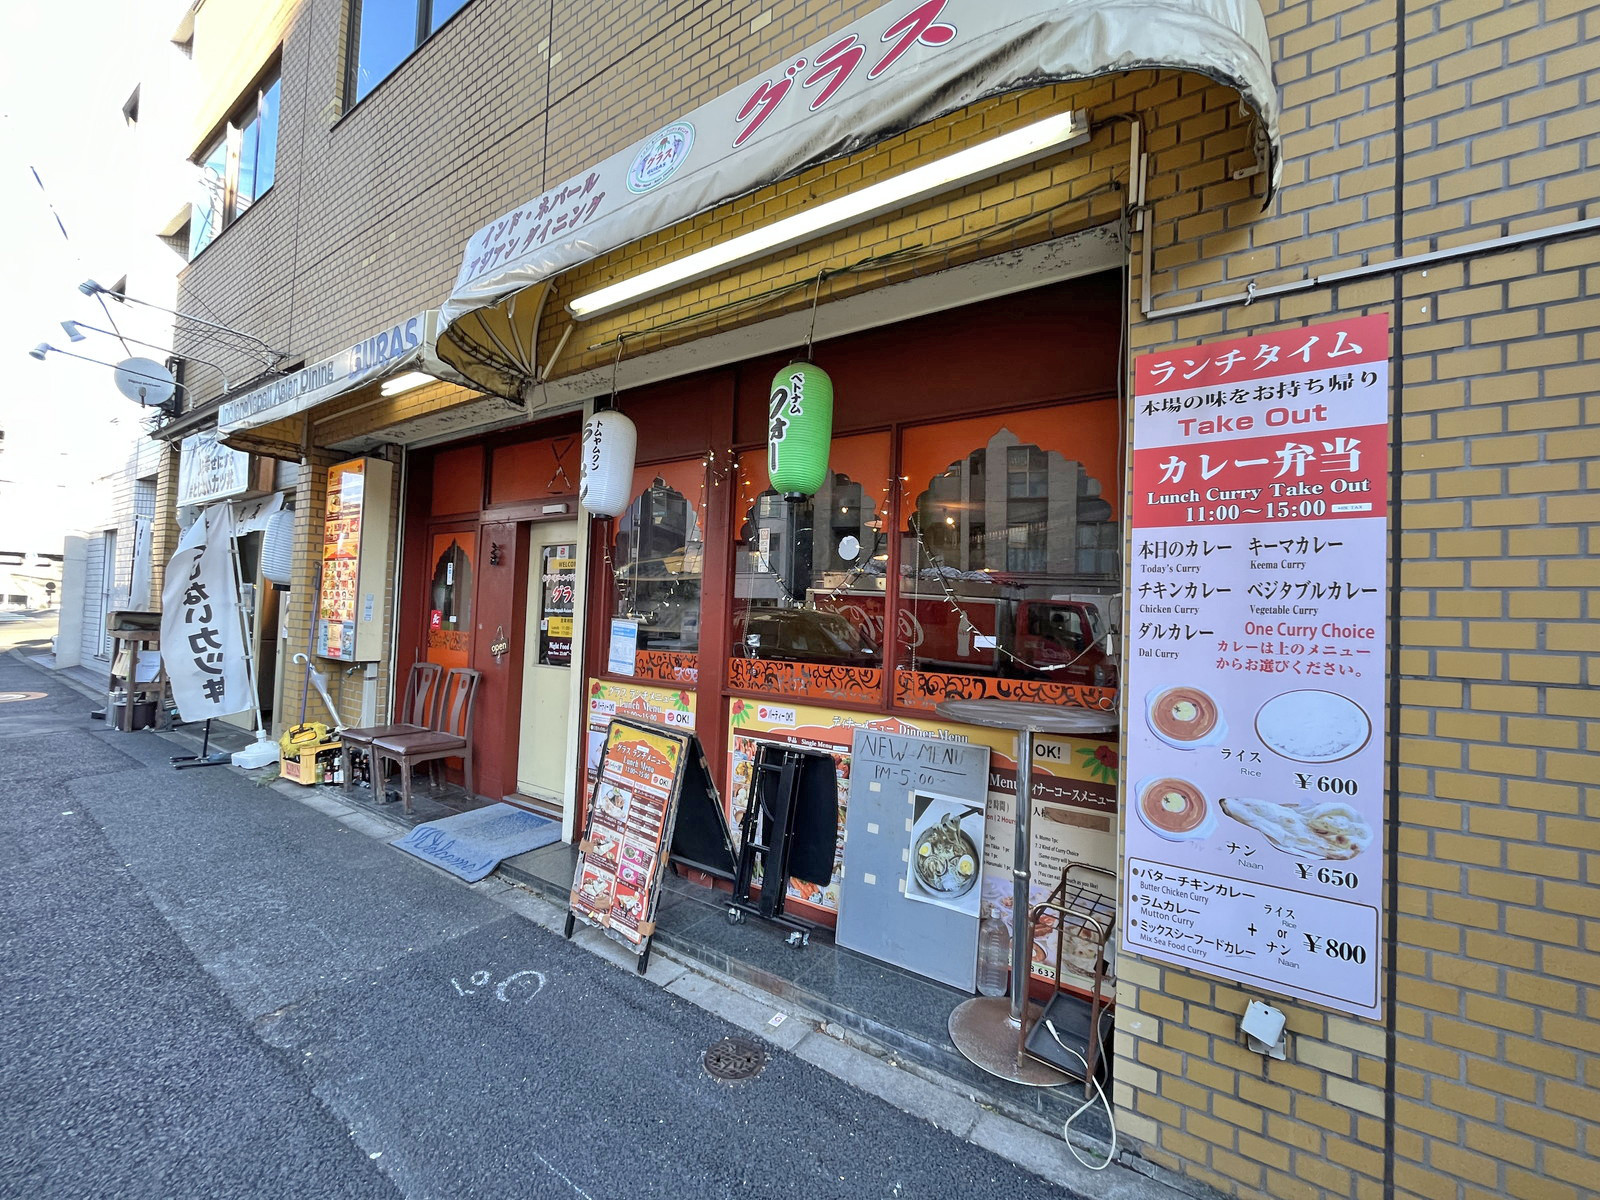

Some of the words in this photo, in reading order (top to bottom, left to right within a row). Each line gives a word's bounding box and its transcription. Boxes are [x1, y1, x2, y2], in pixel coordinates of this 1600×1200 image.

[732, 0, 958, 148] グラス
[646, 148, 673, 170] グラス
[482, 172, 601, 249] インド・ネパール
[349, 317, 419, 379] GURAS
[1150, 331, 1364, 387] ランチタイム
[274, 378, 298, 404] Asian
[301, 361, 334, 392] Dining
[790, 372, 805, 416] ベトナム
[1140, 370, 1378, 417] 本場の味をお持ち帰り
[769, 387, 789, 472] フォー
[1178, 414, 1254, 437] Take
[1265, 404, 1328, 427] Out
[591, 420, 604, 471] トムヤムクン
[1157, 437, 1362, 486] カレー弁当
[1147, 489, 1200, 505] Lunch
[1206, 486, 1261, 502] Curry
[1269, 481, 1323, 498] Take
[1330, 478, 1371, 494] Out
[1138, 540, 1233, 560] 本日のカレー
[1248, 535, 1344, 557] キーマカレー
[1141, 564, 1174, 574] Today's
[1176, 564, 1202, 574] Curry
[1250, 560, 1278, 570] Keema
[1281, 560, 1306, 570] Curry
[1138, 581, 1232, 600] チキンカレー
[1247, 580, 1378, 601] ベジタブルカレー
[1139, 604, 1172, 614] Chicken
[1174, 604, 1200, 615] Curry
[1250, 604, 1290, 615] Vegetable
[1292, 605, 1319, 617] Curry
[1138, 622, 1214, 641] ダルカレー
[1244, 621, 1273, 636] One
[1277, 622, 1318, 641] Curry
[1321, 622, 1375, 640] Choice
[491, 642, 507, 654] open
[1139, 648, 1153, 658] Dal
[1155, 649, 1180, 660] Curry
[1217, 640, 1371, 656] カレーは上のメニュー
[1216, 657, 1363, 678] からお選びください。
[608, 686, 627, 697] グラス
[629, 689, 676, 703] ランチメニュー
[619, 699, 640, 710] Lunch
[642, 701, 662, 713] Menu
[676, 713, 690, 724] OK!
[801, 738, 817, 748] Single
[818, 741, 833, 750] Menu
[899, 724, 935, 739] Dinner
[938, 729, 969, 744] Menu
[617, 744, 631, 755] グラス
[632, 748, 667, 766] ランチメニュー
[1035, 743, 1061, 760] OK!
[1220, 748, 1262, 764] ライス
[623, 755, 639, 768] Lunch
[640, 760, 655, 774] Menu
[1240, 768, 1262, 778] Rice
[1294, 773, 1359, 797] ¥600
[1055, 847, 1066, 856] Curry
[1066, 849, 1080, 857] Choice
[1226, 841, 1257, 857] ナン
[1038, 861, 1047, 869] Plain
[1238, 859, 1264, 871] Naan
[1038, 879, 1052, 888] Dessert
[1139, 868, 1256, 900] バターチキンカレー
[1294, 862, 1359, 890] ¥650
[1140, 881, 1161, 893] Butter
[1161, 885, 1190, 900] Chicken
[1190, 892, 1209, 905] Curry
[1139, 895, 1201, 916] ラムカレー
[1263, 904, 1296, 920] ライス
[1140, 907, 1169, 923] Mutton
[1171, 914, 1195, 928] Curry
[1281, 920, 1297, 929] Rice
[1139, 920, 1257, 957] ミックスシーフードカレー
[1277, 928, 1288, 939] or
[1140, 933, 1152, 943] Mix
[1153, 936, 1166, 947] Sea
[1167, 938, 1186, 952] Food
[1188, 944, 1208, 958] Curry
[1266, 941, 1292, 956] ナン
[1302, 932, 1367, 965] ¥800
[1277, 957, 1300, 970] Naan
